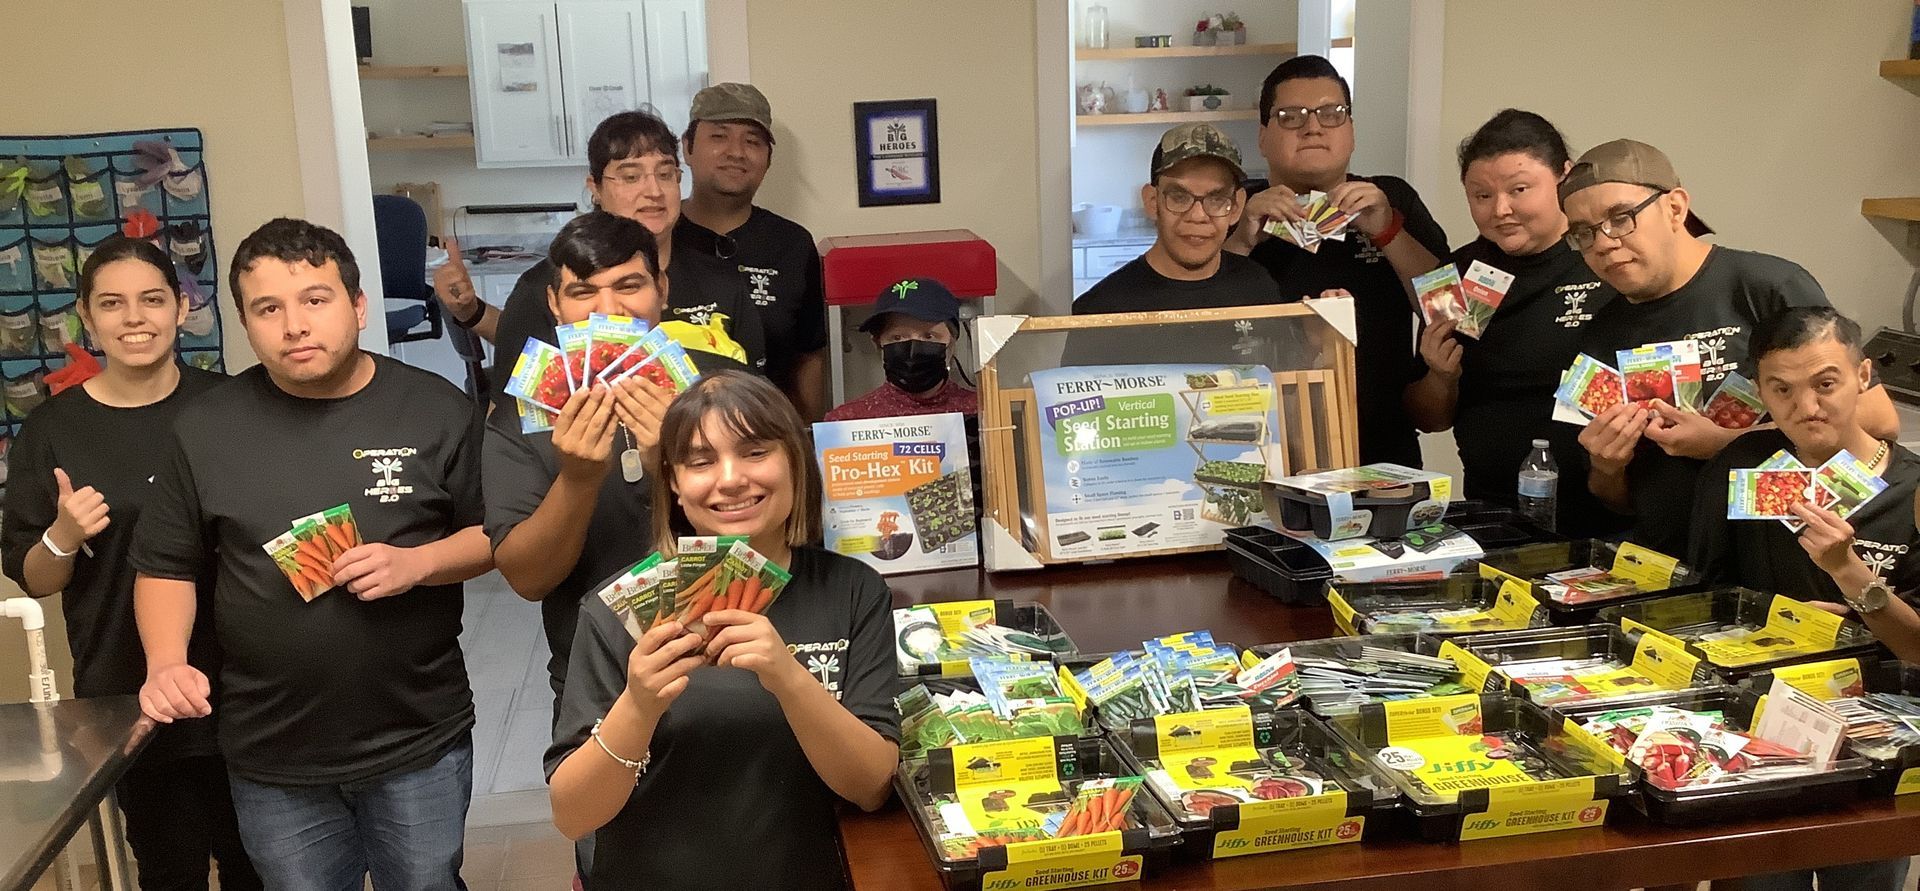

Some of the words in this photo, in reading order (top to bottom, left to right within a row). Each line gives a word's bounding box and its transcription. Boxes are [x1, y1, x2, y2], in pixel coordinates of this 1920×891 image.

[879, 141, 916, 151] HEROES
[1554, 281, 1601, 294] OPERATION
[1683, 326, 1741, 341] OPERATION
[1700, 362, 1738, 375] EROES
[1053, 398, 1101, 418] POP-UP!
[1118, 399, 1156, 411] Vertical
[1062, 416, 1100, 434] Seed
[1106, 412, 1170, 430] Starting
[899, 445, 911, 454] 72
[913, 445, 941, 454] CELLS
[1063, 434, 1121, 452] Station
[352, 447, 417, 459] OPERATION
[828, 453, 851, 463] Seed
[852, 451, 889, 461] Starting
[830, 461, 901, 482] Pro-Hex
[908, 458, 935, 475] Kit
[364, 486, 413, 497] HEROES
[631, 590, 656, 605] CARROT
[1381, 751, 1406, 765] 25
[1427, 759, 1496, 774] Jiffy
[1433, 774, 1530, 791] GREENHOUSE
[1465, 819, 1501, 830] Jiffy
[1506, 813, 1559, 828] GREENHOUSE
[1561, 810, 1576, 820] KIT
[1584, 808, 1597, 819] 25
[1337, 824, 1352, 836] 25
[1217, 838, 1250, 849] Jiffy
[1254, 831, 1315, 847] GREENHOUSE
[1317, 828, 1333, 839] KIT
[1114, 863, 1129, 875] 25
[986, 878, 1021, 890] Jiffy
[1025, 869, 1090, 887] GREENHOUSE
[1092, 868, 1110, 879] KIT
